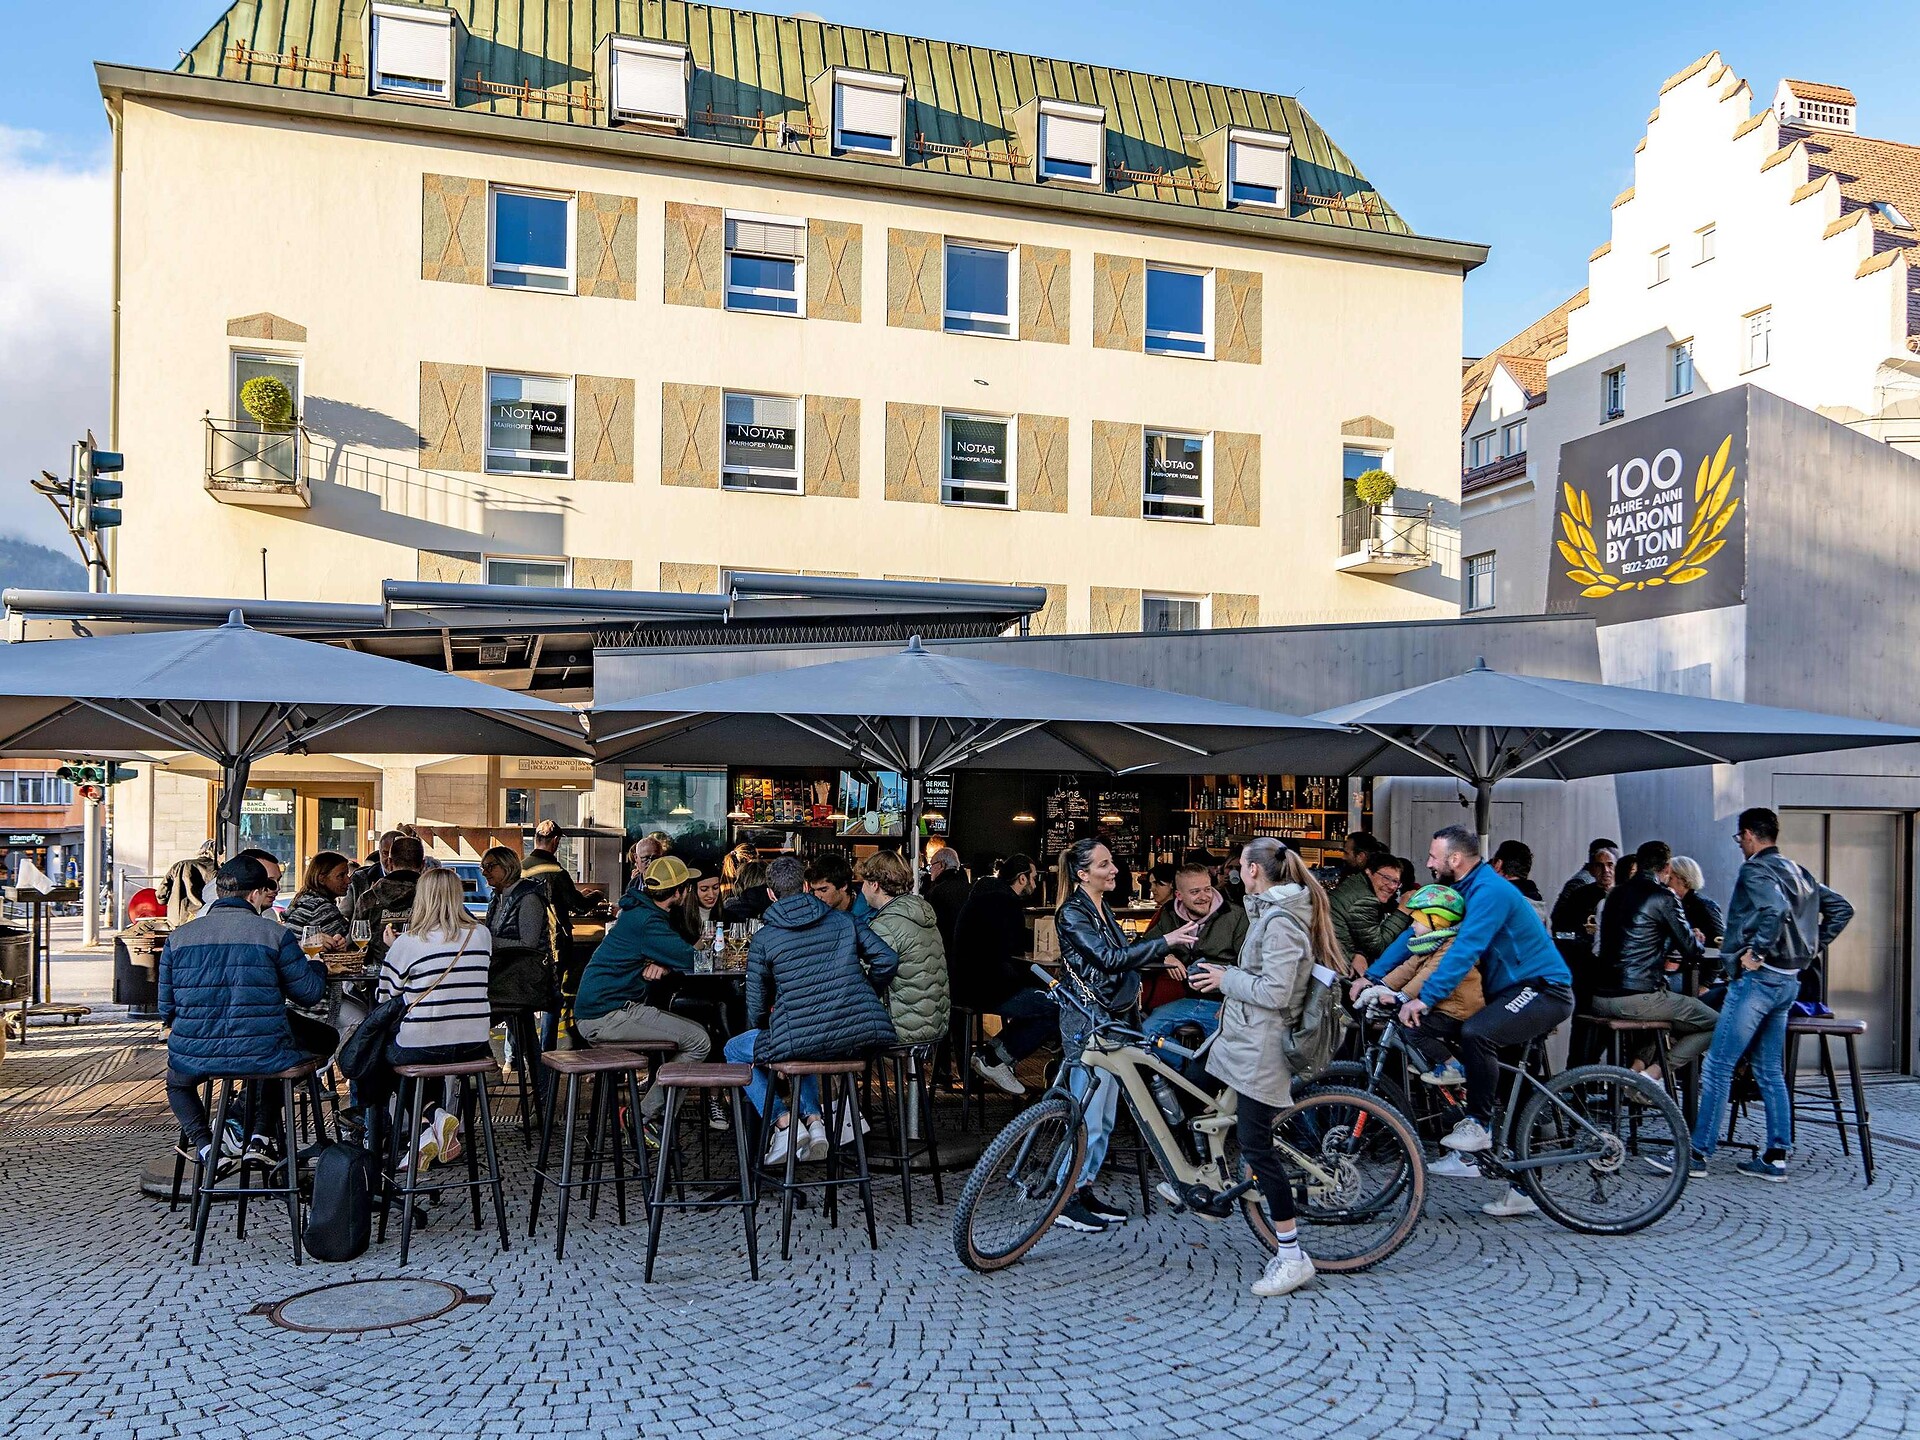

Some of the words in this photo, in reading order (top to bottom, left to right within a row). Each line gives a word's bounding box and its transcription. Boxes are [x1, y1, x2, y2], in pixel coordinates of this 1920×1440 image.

[1606, 448, 1683, 502] 100
[1606, 502, 1683, 540] MARONI
[1607, 498, 1643, 517] JAHRE
[1652, 487, 1683, 506] ANNI
[1606, 537, 1631, 563] BY
[1634, 525, 1683, 557] TONI
[1621, 555, 1669, 574] 1922-2022
